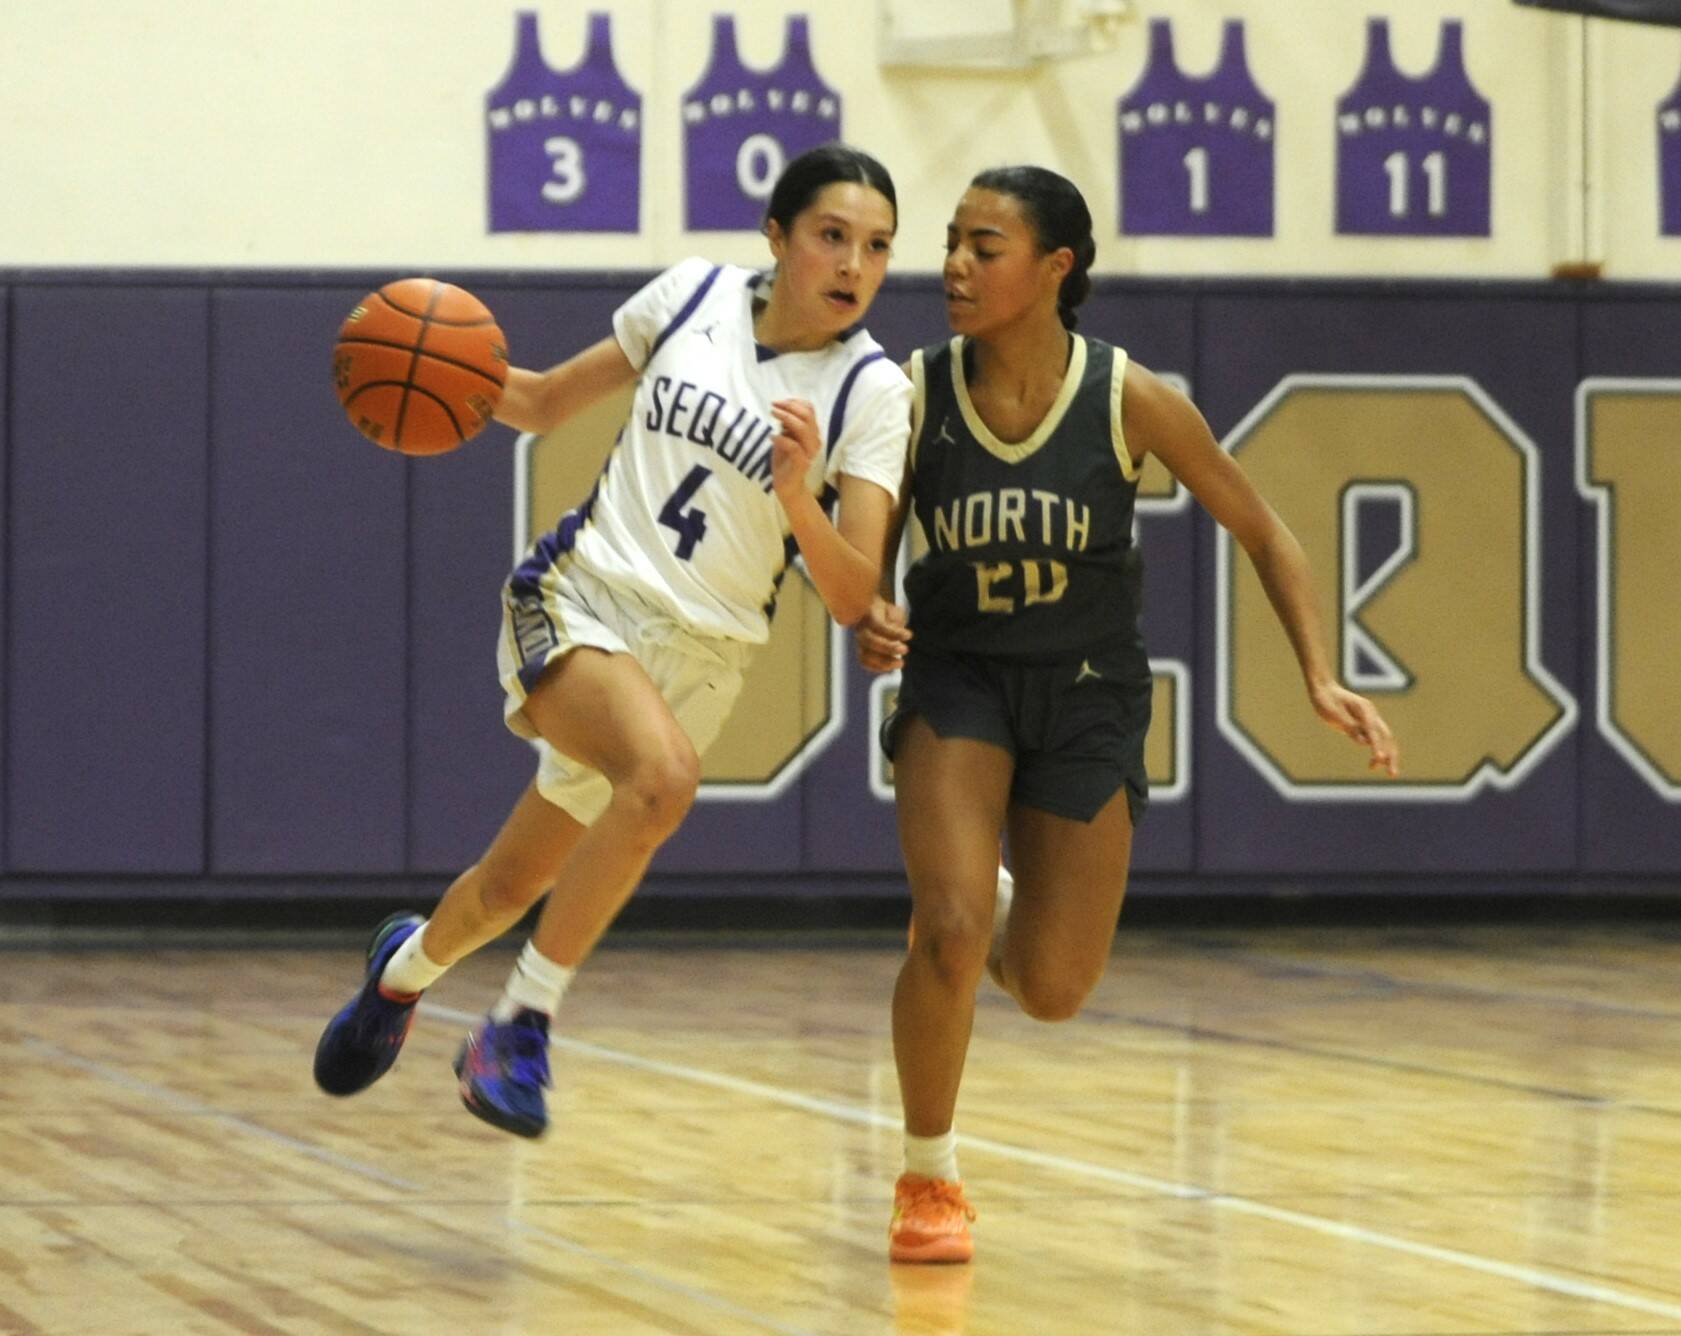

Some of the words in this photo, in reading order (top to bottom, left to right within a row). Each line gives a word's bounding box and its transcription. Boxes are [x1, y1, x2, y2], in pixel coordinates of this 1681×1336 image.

[541, 136, 586, 204] 3
[736, 133, 784, 200] 0
[1183, 147, 1209, 212] 1
[1384, 151, 1447, 216] 11
[657, 463, 713, 561] 4
[934, 487, 1090, 551] NORTH
